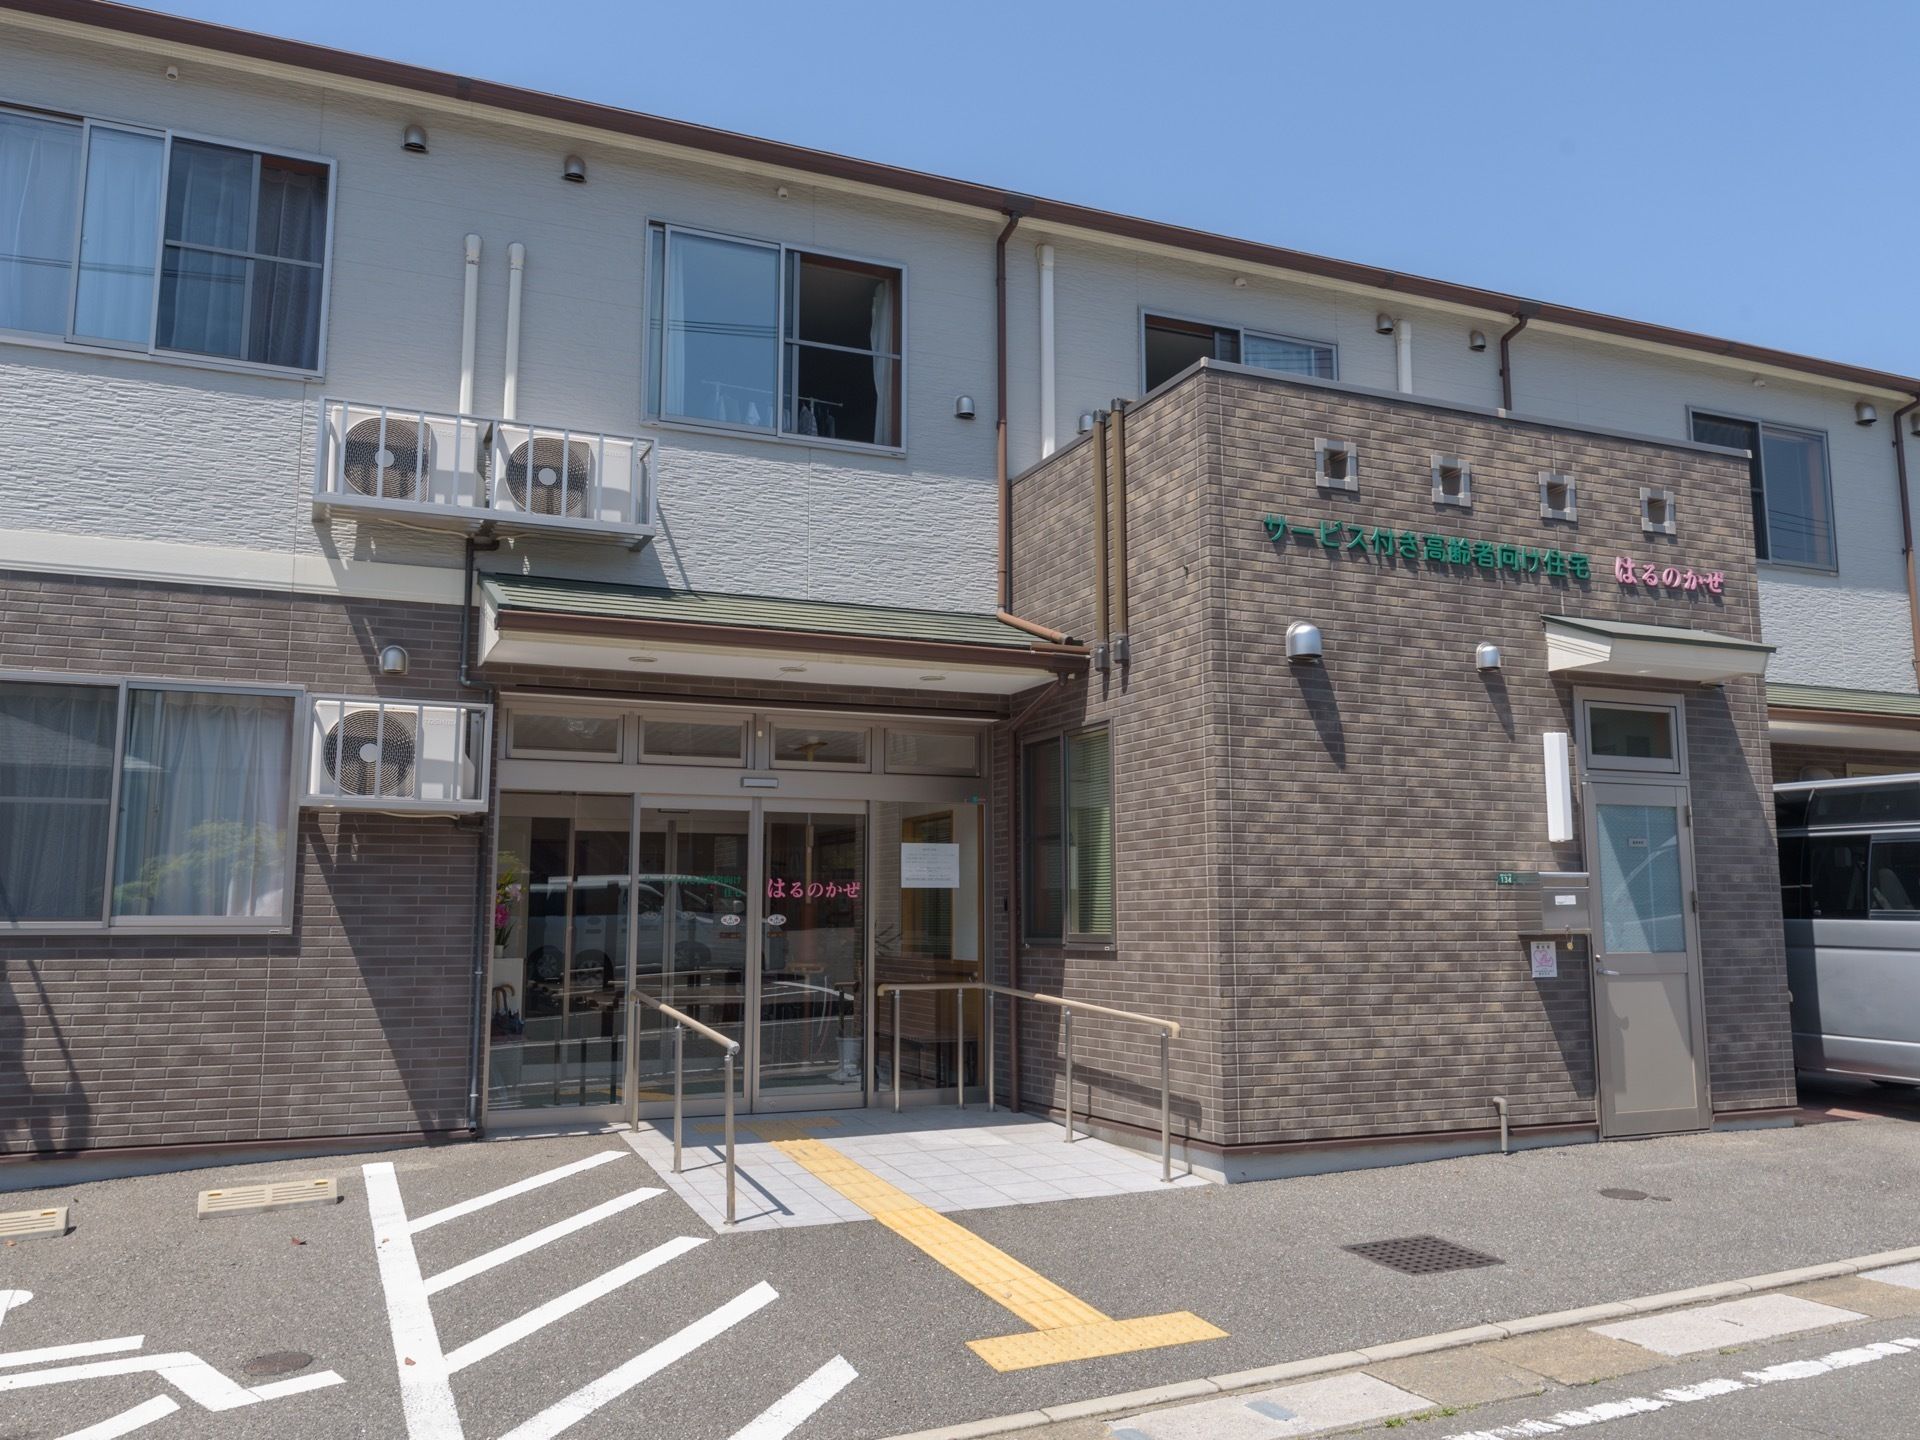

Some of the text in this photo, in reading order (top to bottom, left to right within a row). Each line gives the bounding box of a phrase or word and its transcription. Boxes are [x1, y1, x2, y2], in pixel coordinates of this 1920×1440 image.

[1264, 514, 1591, 579] サービス付き高齢者向け住宅
[1614, 556, 1725, 594] はるのかぜ
[767, 878, 861, 899] はるのかぜ
